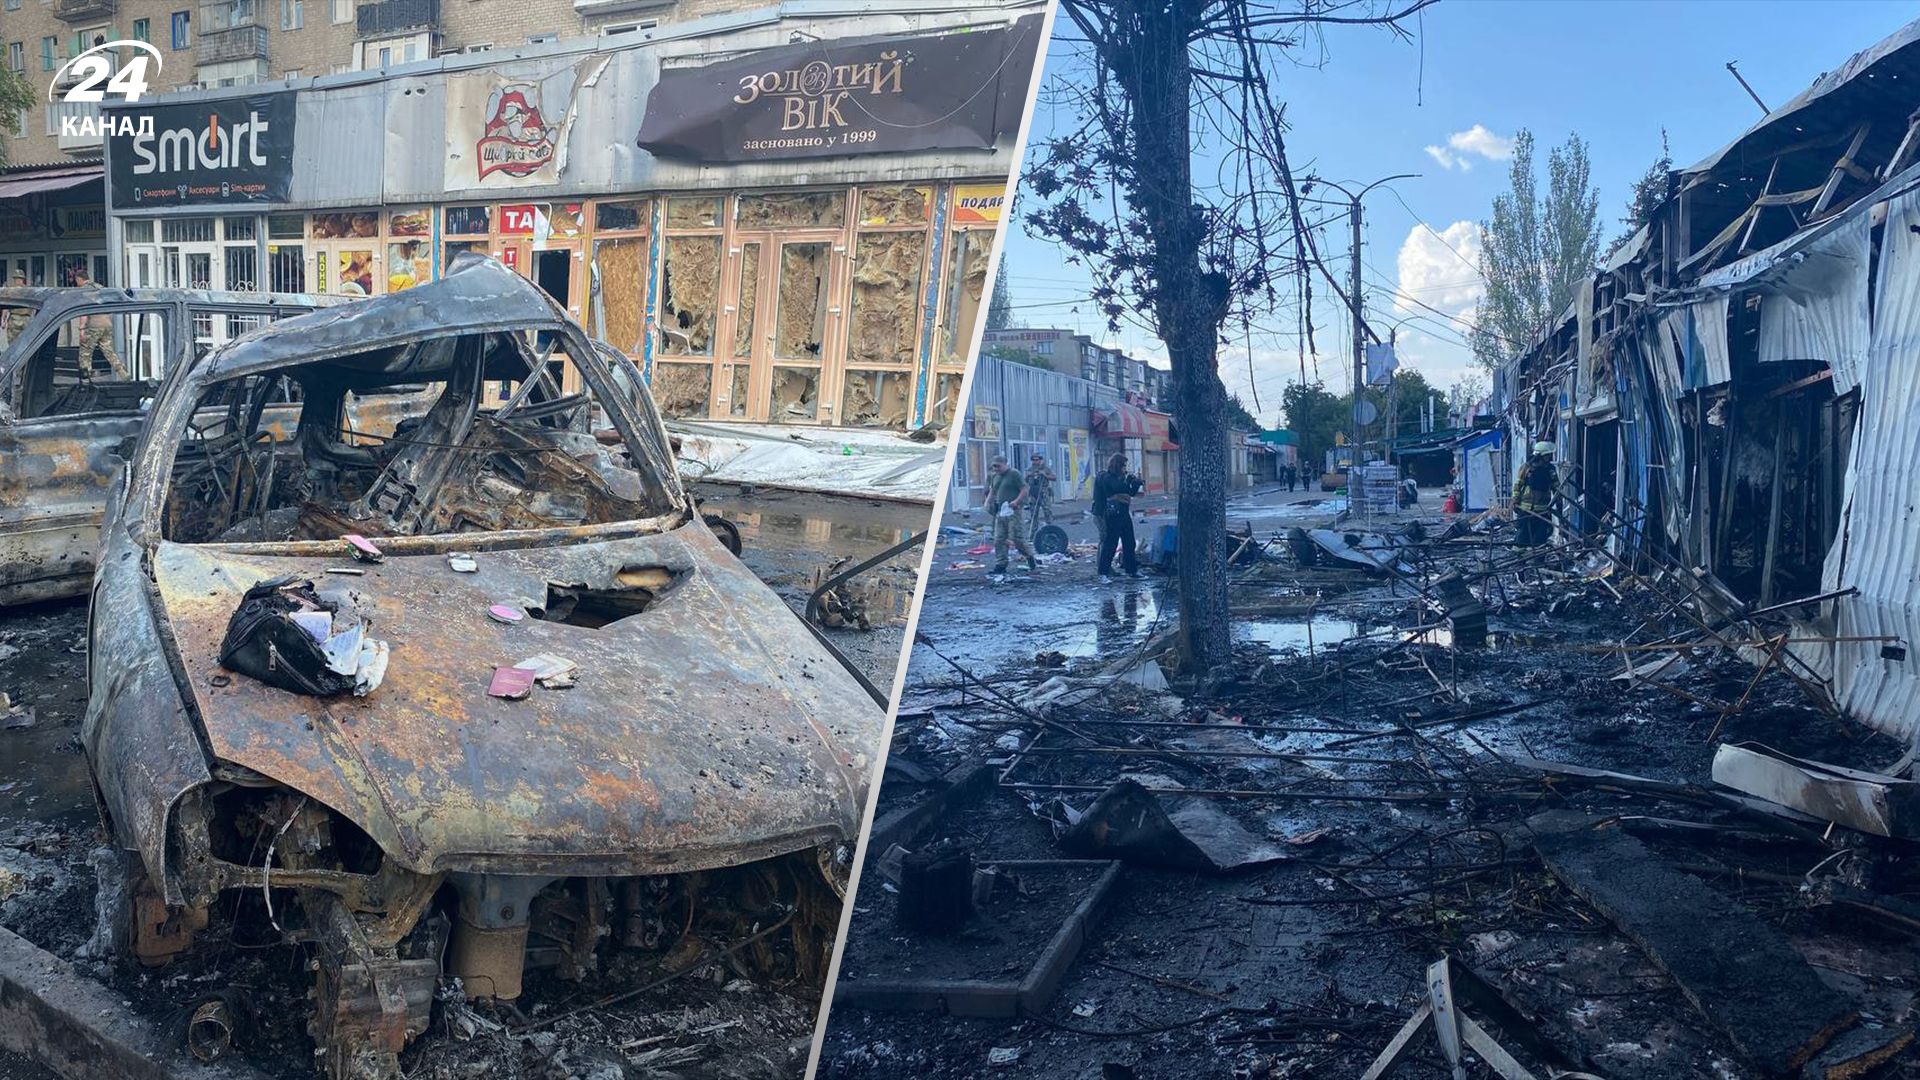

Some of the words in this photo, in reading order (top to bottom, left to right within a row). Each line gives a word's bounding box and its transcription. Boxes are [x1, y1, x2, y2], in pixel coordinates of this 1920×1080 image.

[781, 91, 848, 131] ВІК
[133, 111, 269, 174] smart
[743, 137, 823, 150] засновано
[826, 135, 836, 148] у
[841, 130, 877, 145] 1999
